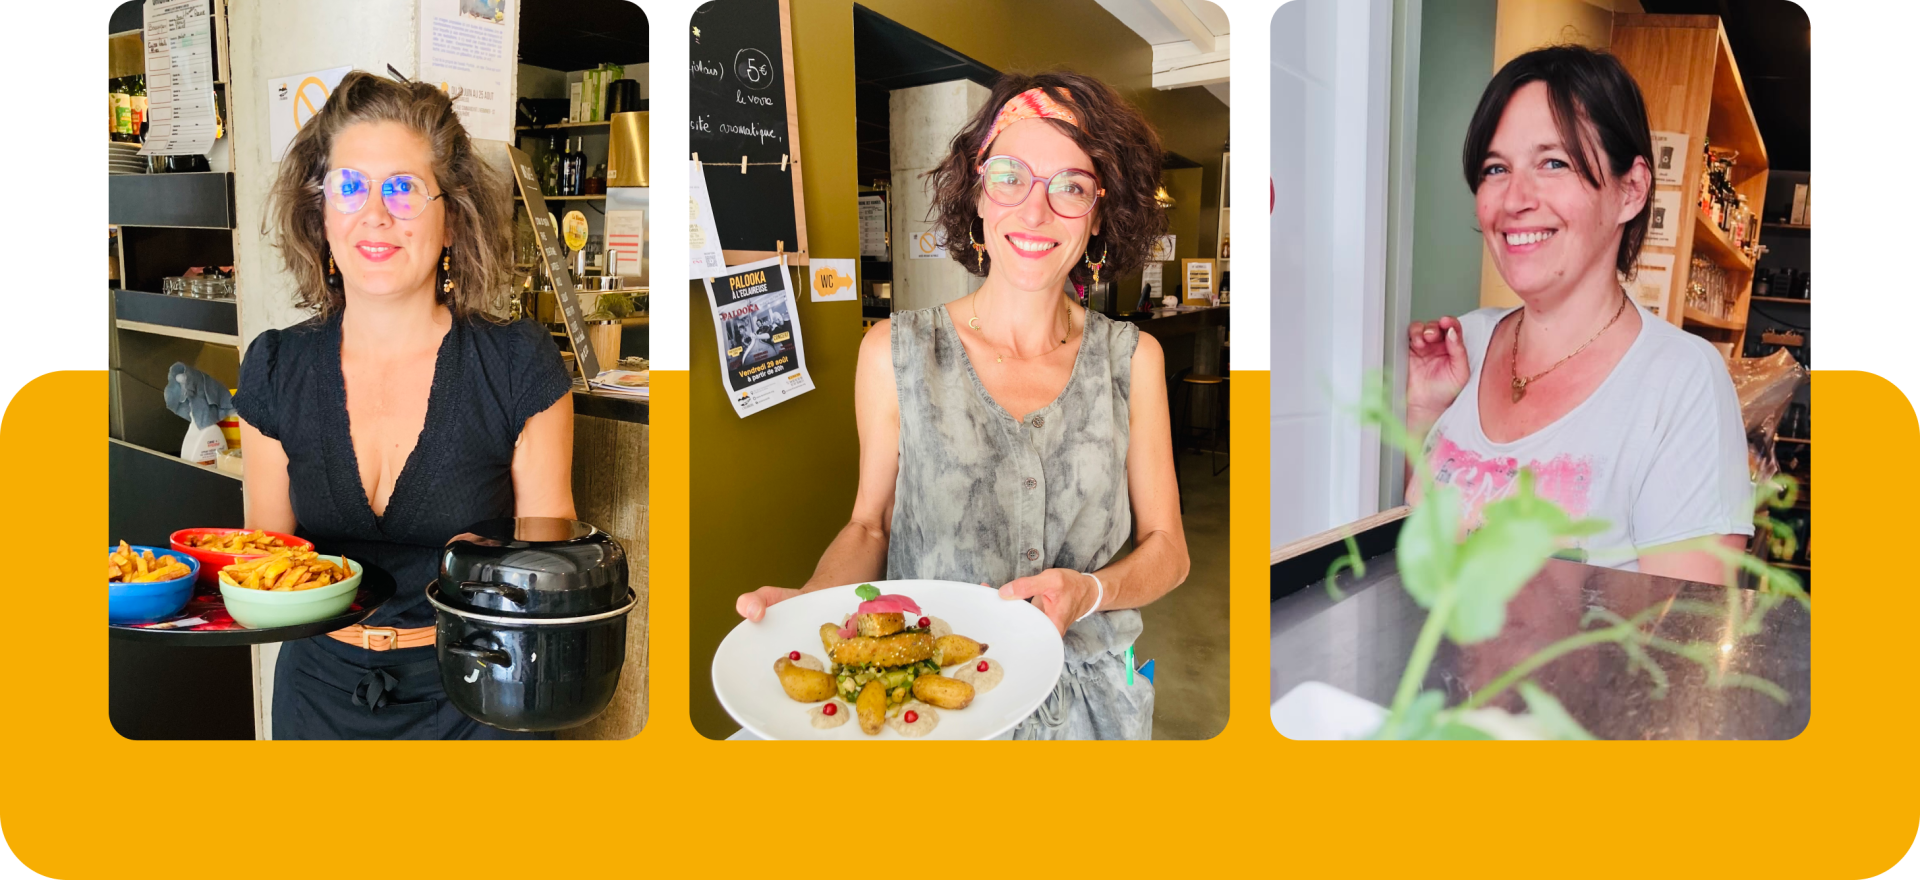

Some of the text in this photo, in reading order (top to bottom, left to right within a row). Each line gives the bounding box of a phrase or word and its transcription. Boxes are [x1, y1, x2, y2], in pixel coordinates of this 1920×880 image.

[689, 58, 768, 82] jolais) 5€
[729, 271, 766, 290] PALOOKA
[820, 274, 834, 289] WC
[721, 304, 760, 320] PALOOKA
[738, 363, 767, 378] Vendredi
[775, 355, 789, 366] août
[752, 370, 767, 382] partir
[774, 364, 785, 374] 20h
